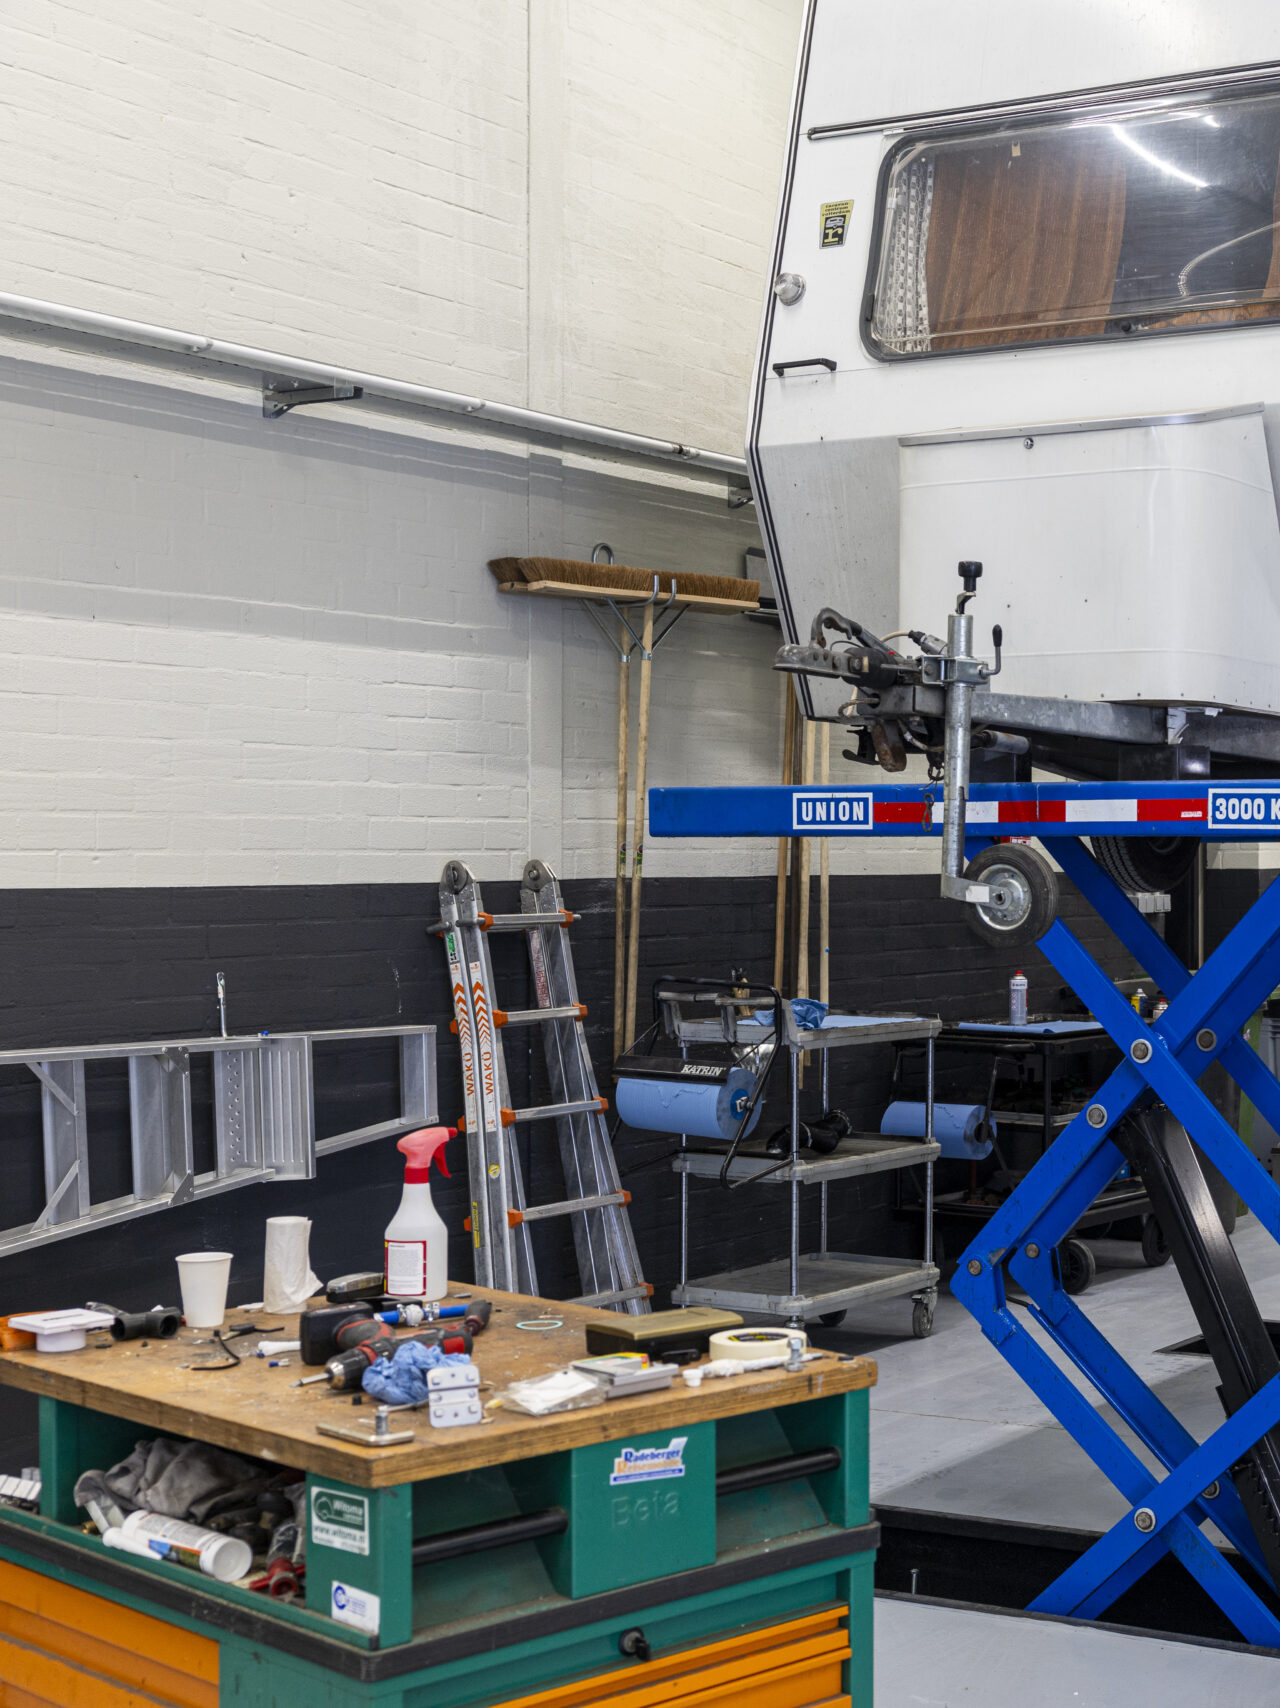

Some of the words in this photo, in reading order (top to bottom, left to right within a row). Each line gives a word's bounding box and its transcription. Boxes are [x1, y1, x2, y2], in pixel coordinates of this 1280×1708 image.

[801, 801, 864, 821] UNION
[1215, 798, 1265, 820] 3000
[463, 1052, 475, 1097] WAKÜ
[482, 1051, 494, 1096] WAKÜ
[680, 1064, 723, 1077] KATRIN
[624, 1450, 681, 1463] Radeberger
